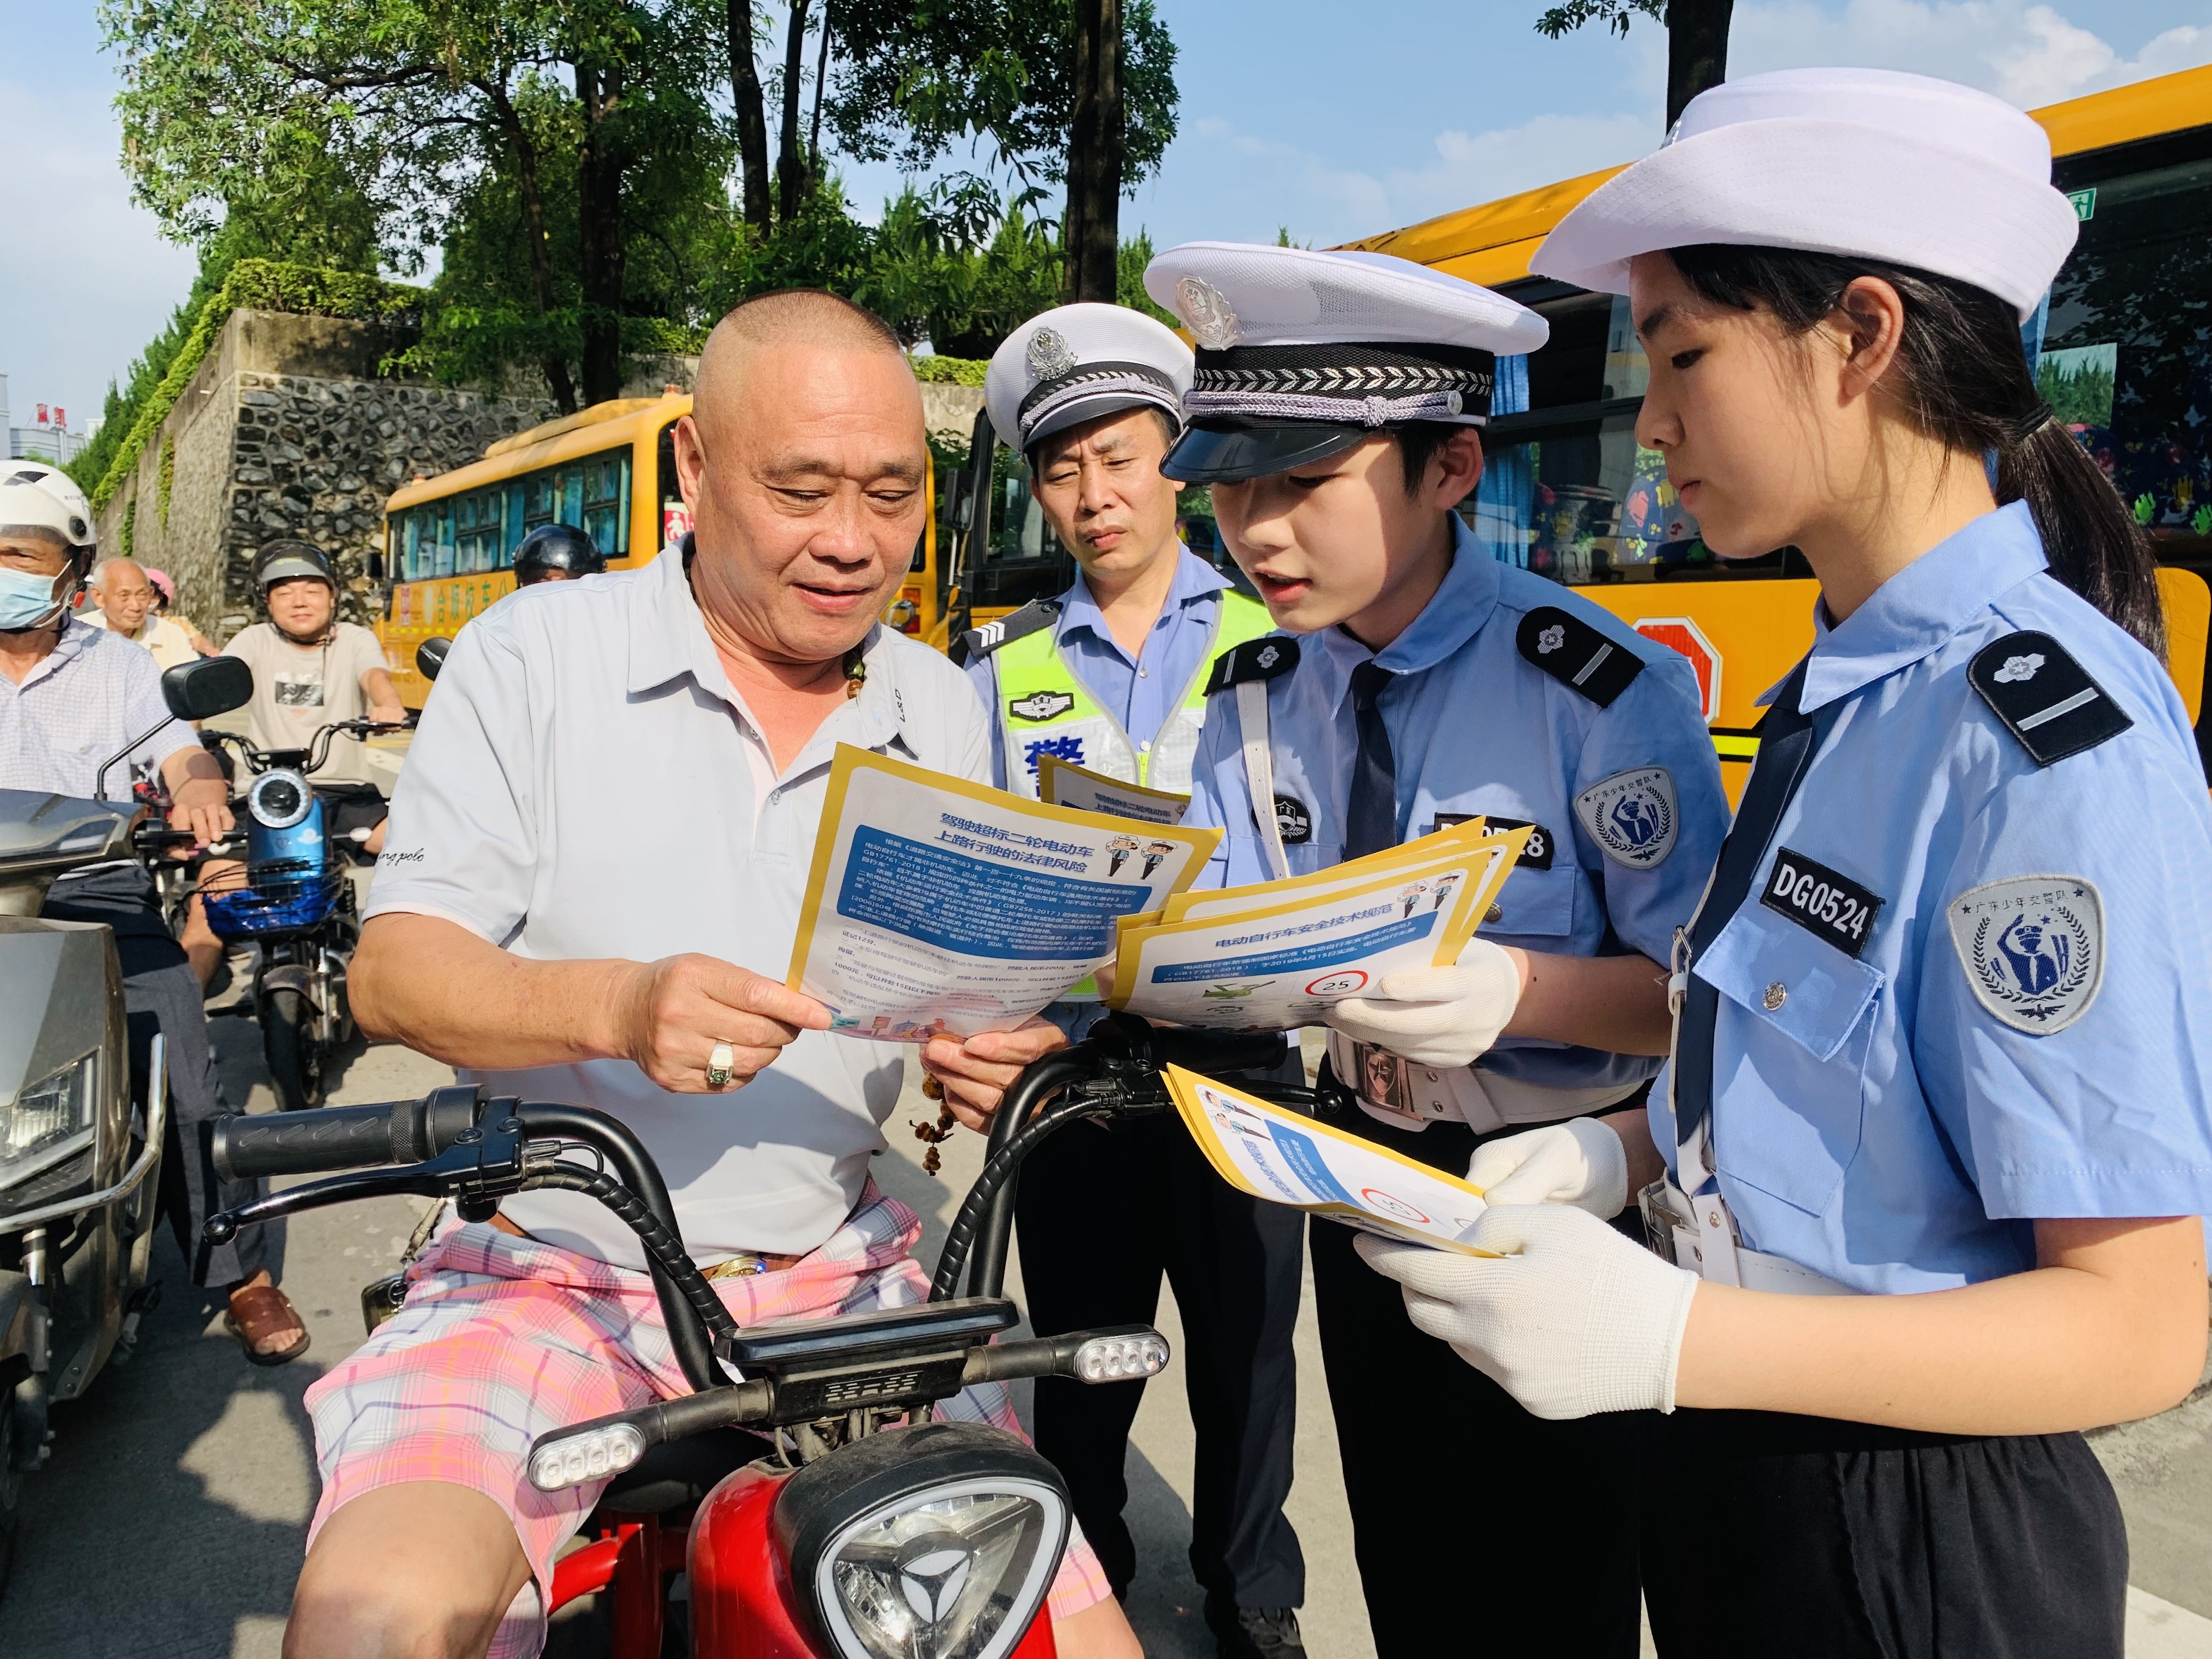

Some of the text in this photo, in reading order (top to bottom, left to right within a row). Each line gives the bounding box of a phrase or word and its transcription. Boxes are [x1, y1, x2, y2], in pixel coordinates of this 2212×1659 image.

[934, 830, 1087, 873] 上路行驶的法律风险
[940, 812, 1094, 857] 驾驶超标二轮电动车
[395, 848, 425, 867] polo
[1773, 864, 1869, 940] DG0524
[1976, 890, 2069, 913] 广东少年交警队
[1215, 903, 1394, 947] 电动自行车安全技术规范
[1322, 980, 1350, 991] 25
